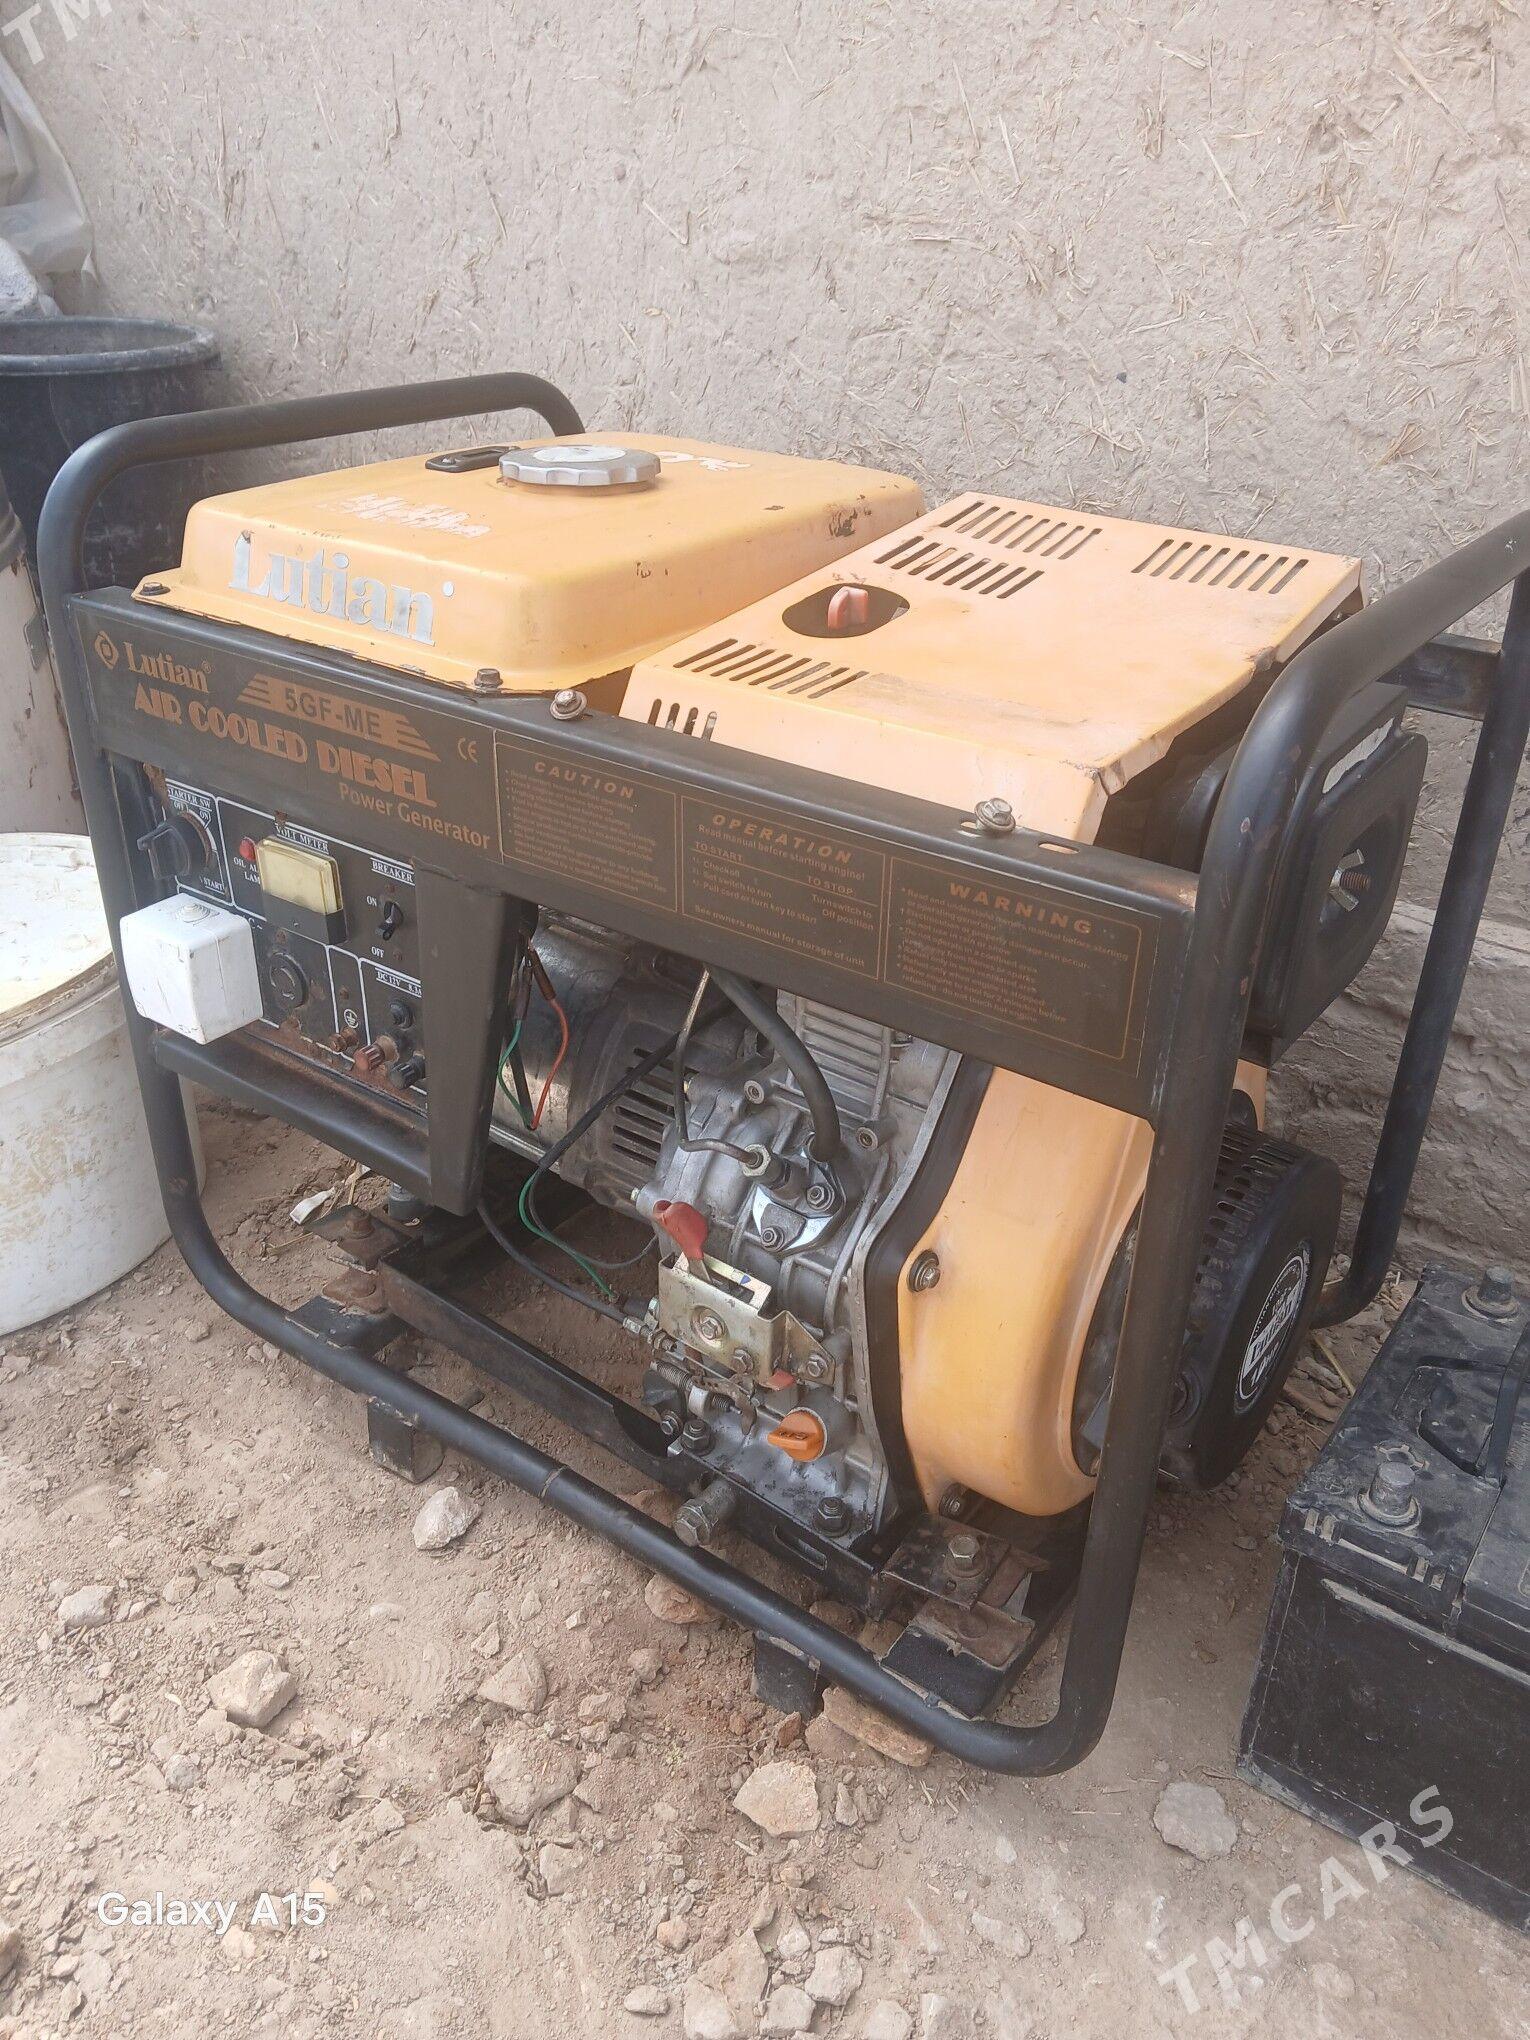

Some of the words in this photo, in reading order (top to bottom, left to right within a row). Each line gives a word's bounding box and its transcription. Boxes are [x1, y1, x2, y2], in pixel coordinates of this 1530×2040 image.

[228, 530, 436, 647] Lutian
[284, 688, 382, 739] 5GF-ME
[134, 683, 183, 726] AIR
[188, 700, 308, 763] COOLED
[318, 740, 437, 808] DIESEL
[534, 761, 635, 799] CAUTION
[339, 782, 396, 819] Power
[398, 803, 491, 850] Generator
[276, 825, 297, 841] VOLT
[299, 832, 329, 853] METER
[711, 813, 852, 864] OPERATION
[723, 831, 755, 849] manual
[695, 841, 707, 851] TO
[710, 845, 742, 862] START
[371, 860, 414, 883] BREAKER
[203, 879, 224, 890] START
[703, 881, 718, 893] Pull
[808, 875, 820, 886] TO
[823, 879, 853, 896] STOP
[366, 895, 378, 906] ON
[949, 882, 1093, 935] WARNING
[747, 921, 779, 939] manual
[836, 912, 873, 932] position
[371, 946, 385, 958] OFF
[377, 971, 388, 981] DC
